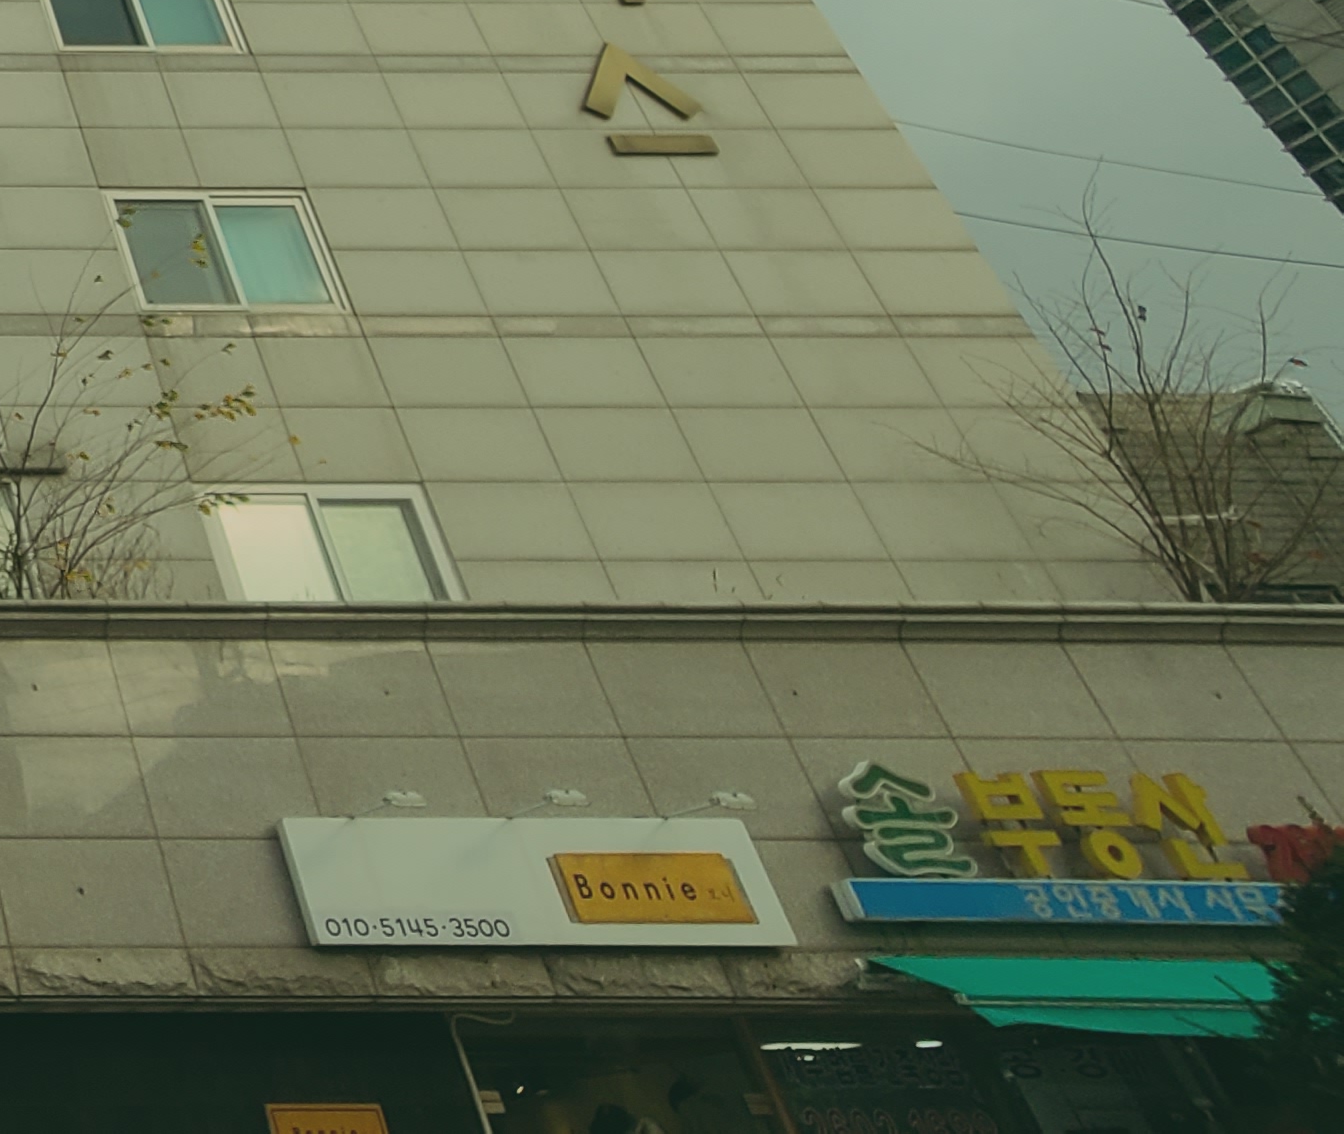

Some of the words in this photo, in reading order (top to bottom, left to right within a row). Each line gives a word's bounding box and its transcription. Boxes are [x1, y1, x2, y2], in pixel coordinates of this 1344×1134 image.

[838, 760, 978, 878] 솔
[953, 769, 1250, 880] 부동산
[573, 873, 698, 901] Bonnie
[1018, 884, 1198, 920] 공인중개사
